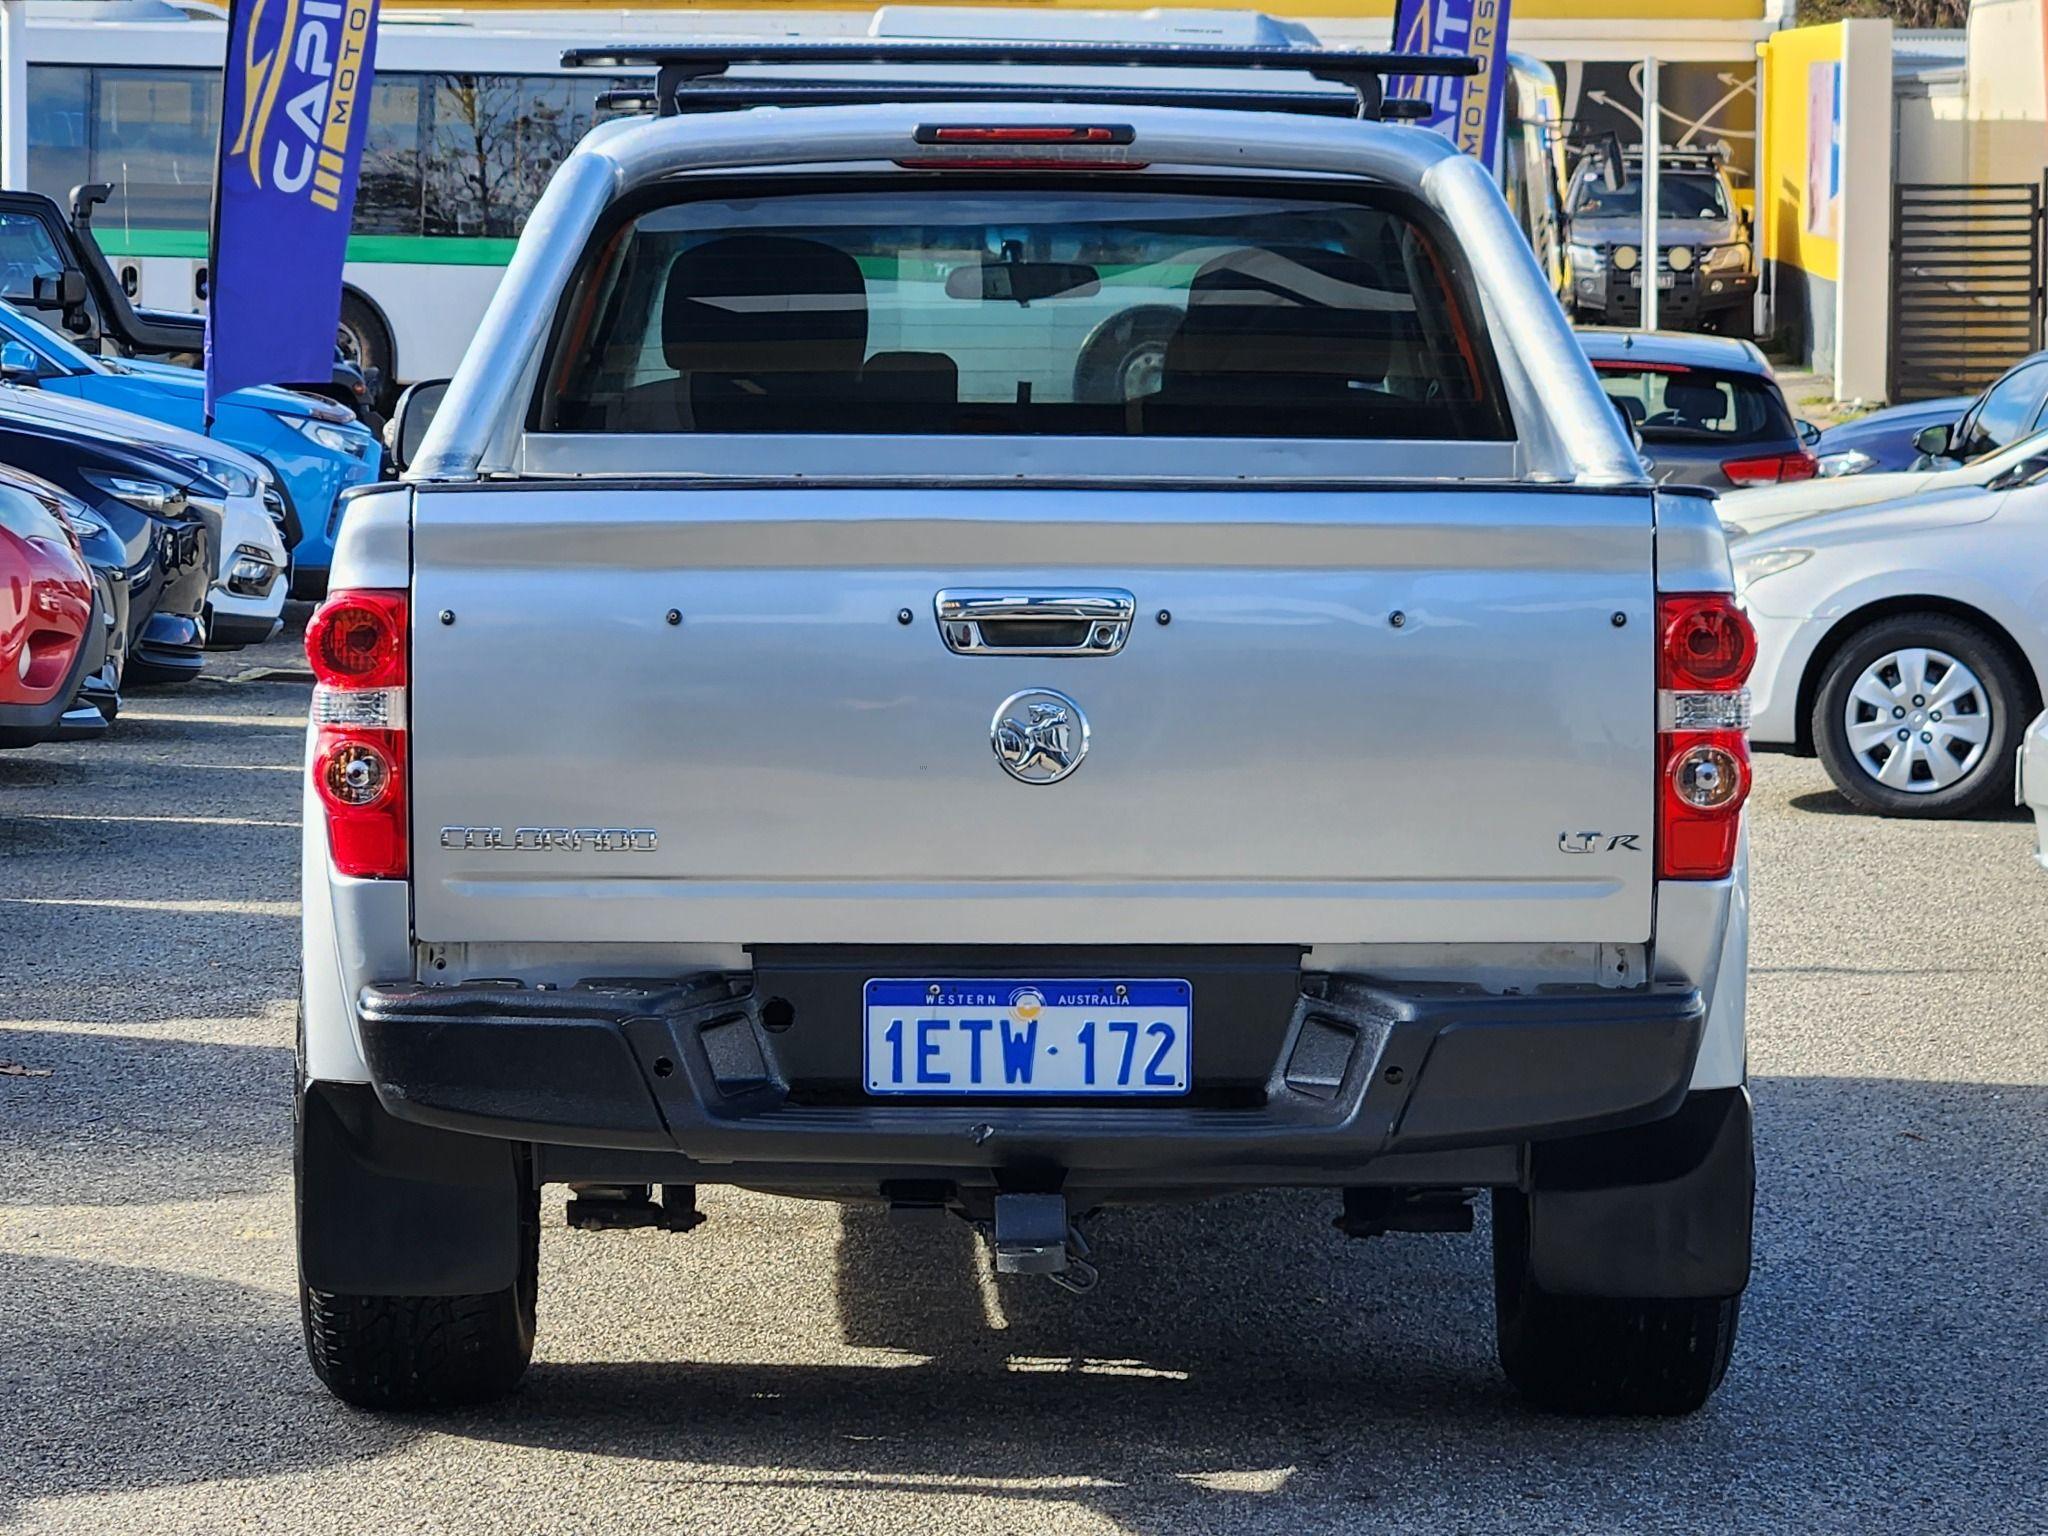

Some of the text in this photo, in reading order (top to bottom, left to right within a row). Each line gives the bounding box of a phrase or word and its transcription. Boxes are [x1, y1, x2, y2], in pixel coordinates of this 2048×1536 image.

[272, 0, 343, 193] CAPI
[331, 8, 367, 124] MOTO
[440, 826, 657, 851] COLORADO
[925, 994, 1130, 1005] WESTERN AUSTRALIA
